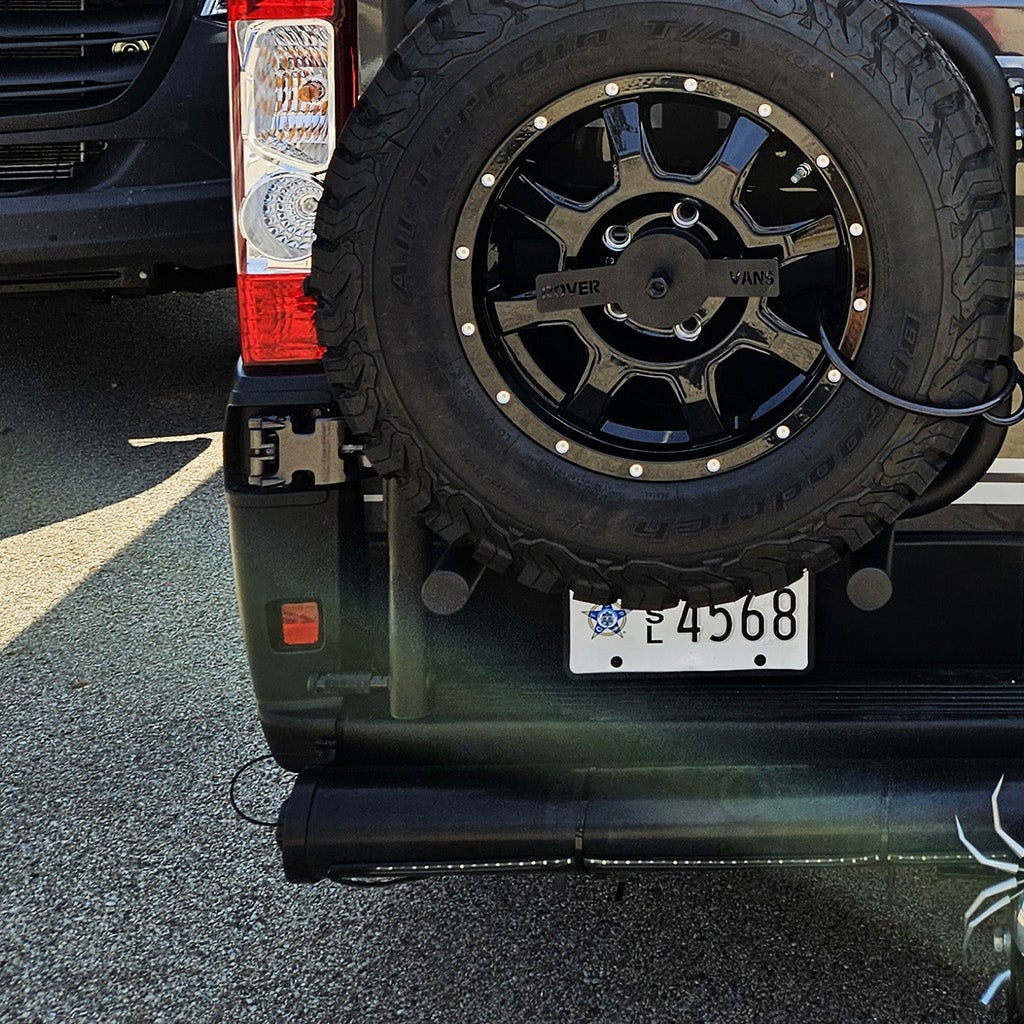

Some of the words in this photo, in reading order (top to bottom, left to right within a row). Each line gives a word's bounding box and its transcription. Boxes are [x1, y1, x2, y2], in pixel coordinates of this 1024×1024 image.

[541, 280, 600, 300] ROVER
[729, 270, 775, 287] VANS
[677, 588, 797, 642] 4568
